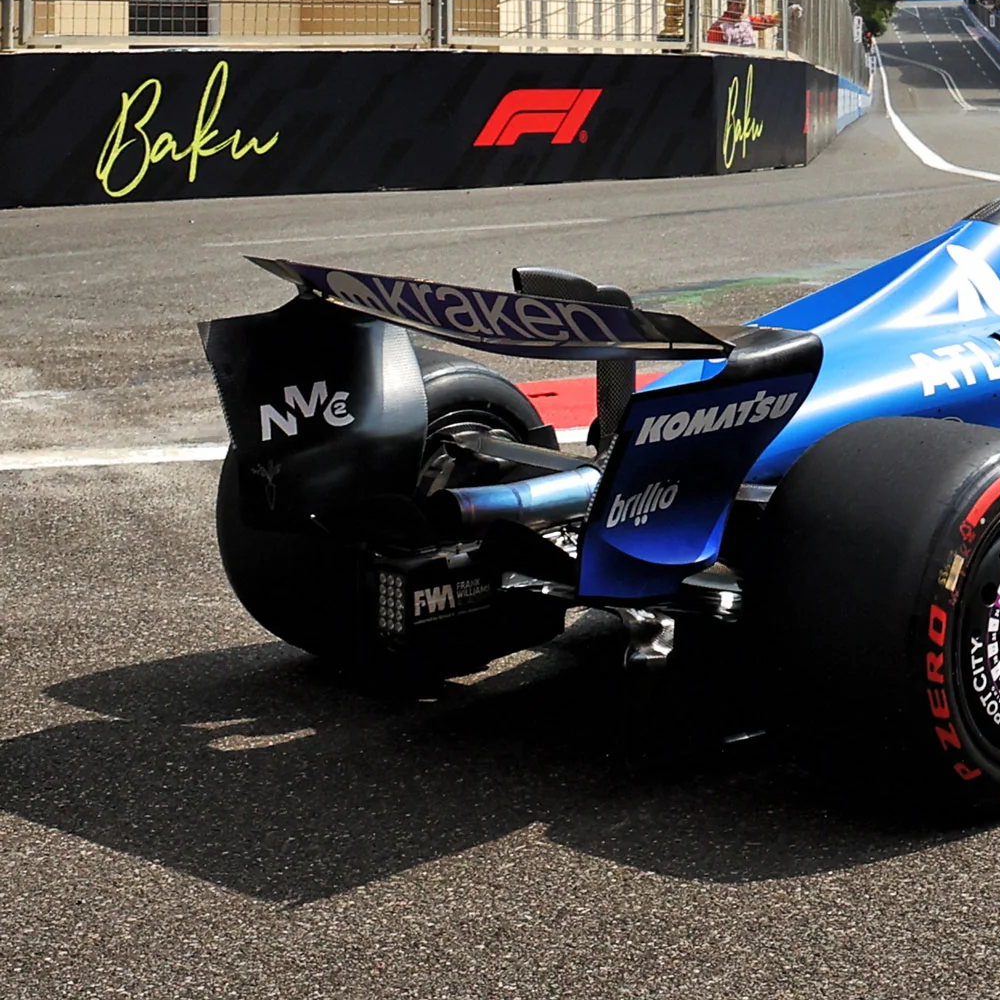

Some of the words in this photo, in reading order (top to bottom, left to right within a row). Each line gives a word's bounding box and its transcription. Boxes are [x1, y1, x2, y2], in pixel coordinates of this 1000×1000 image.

[96, 60, 280, 198] Baku
[723, 63, 764, 169] Baku
[634, 390, 798, 446] KOMATSU
[926, 604, 961, 750] ZERO
[970, 636, 988, 692] CITY
[953, 762, 982, 780] P
